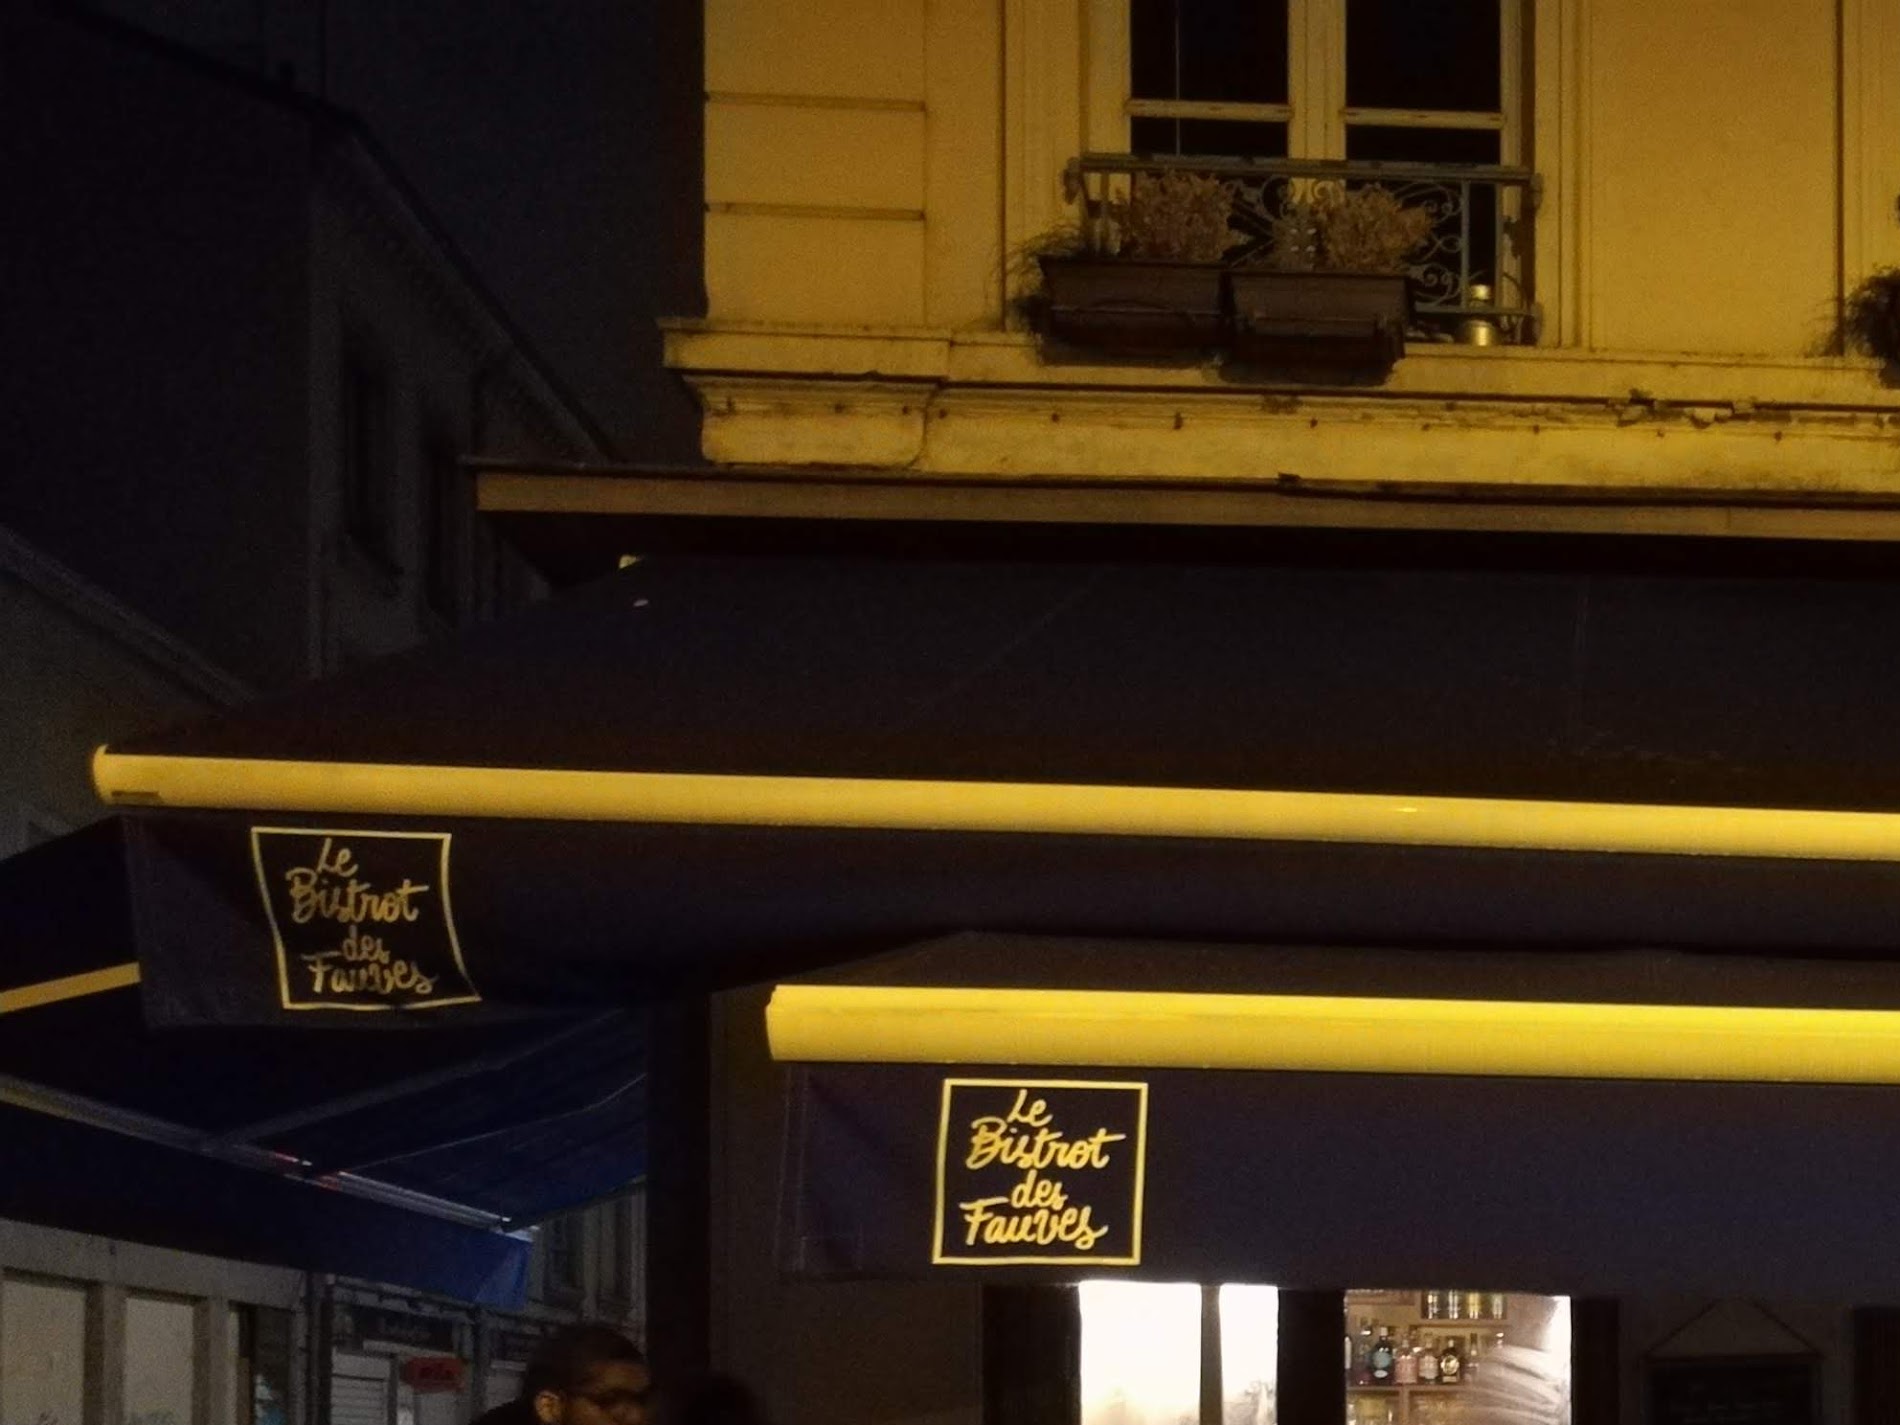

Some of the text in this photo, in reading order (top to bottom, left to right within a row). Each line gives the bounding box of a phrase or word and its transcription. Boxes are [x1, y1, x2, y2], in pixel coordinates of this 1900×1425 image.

[316, 837, 359, 878] Le
[285, 867, 429, 923] Bistrot
[341, 925, 391, 964] des
[300, 951, 438, 994] Fauves
[1007, 1089, 1053, 1127] Le
[966, 1116, 1126, 1169] Bistrot
[1011, 1169, 1069, 1209] des
[959, 1196, 1108, 1251] Fauves
